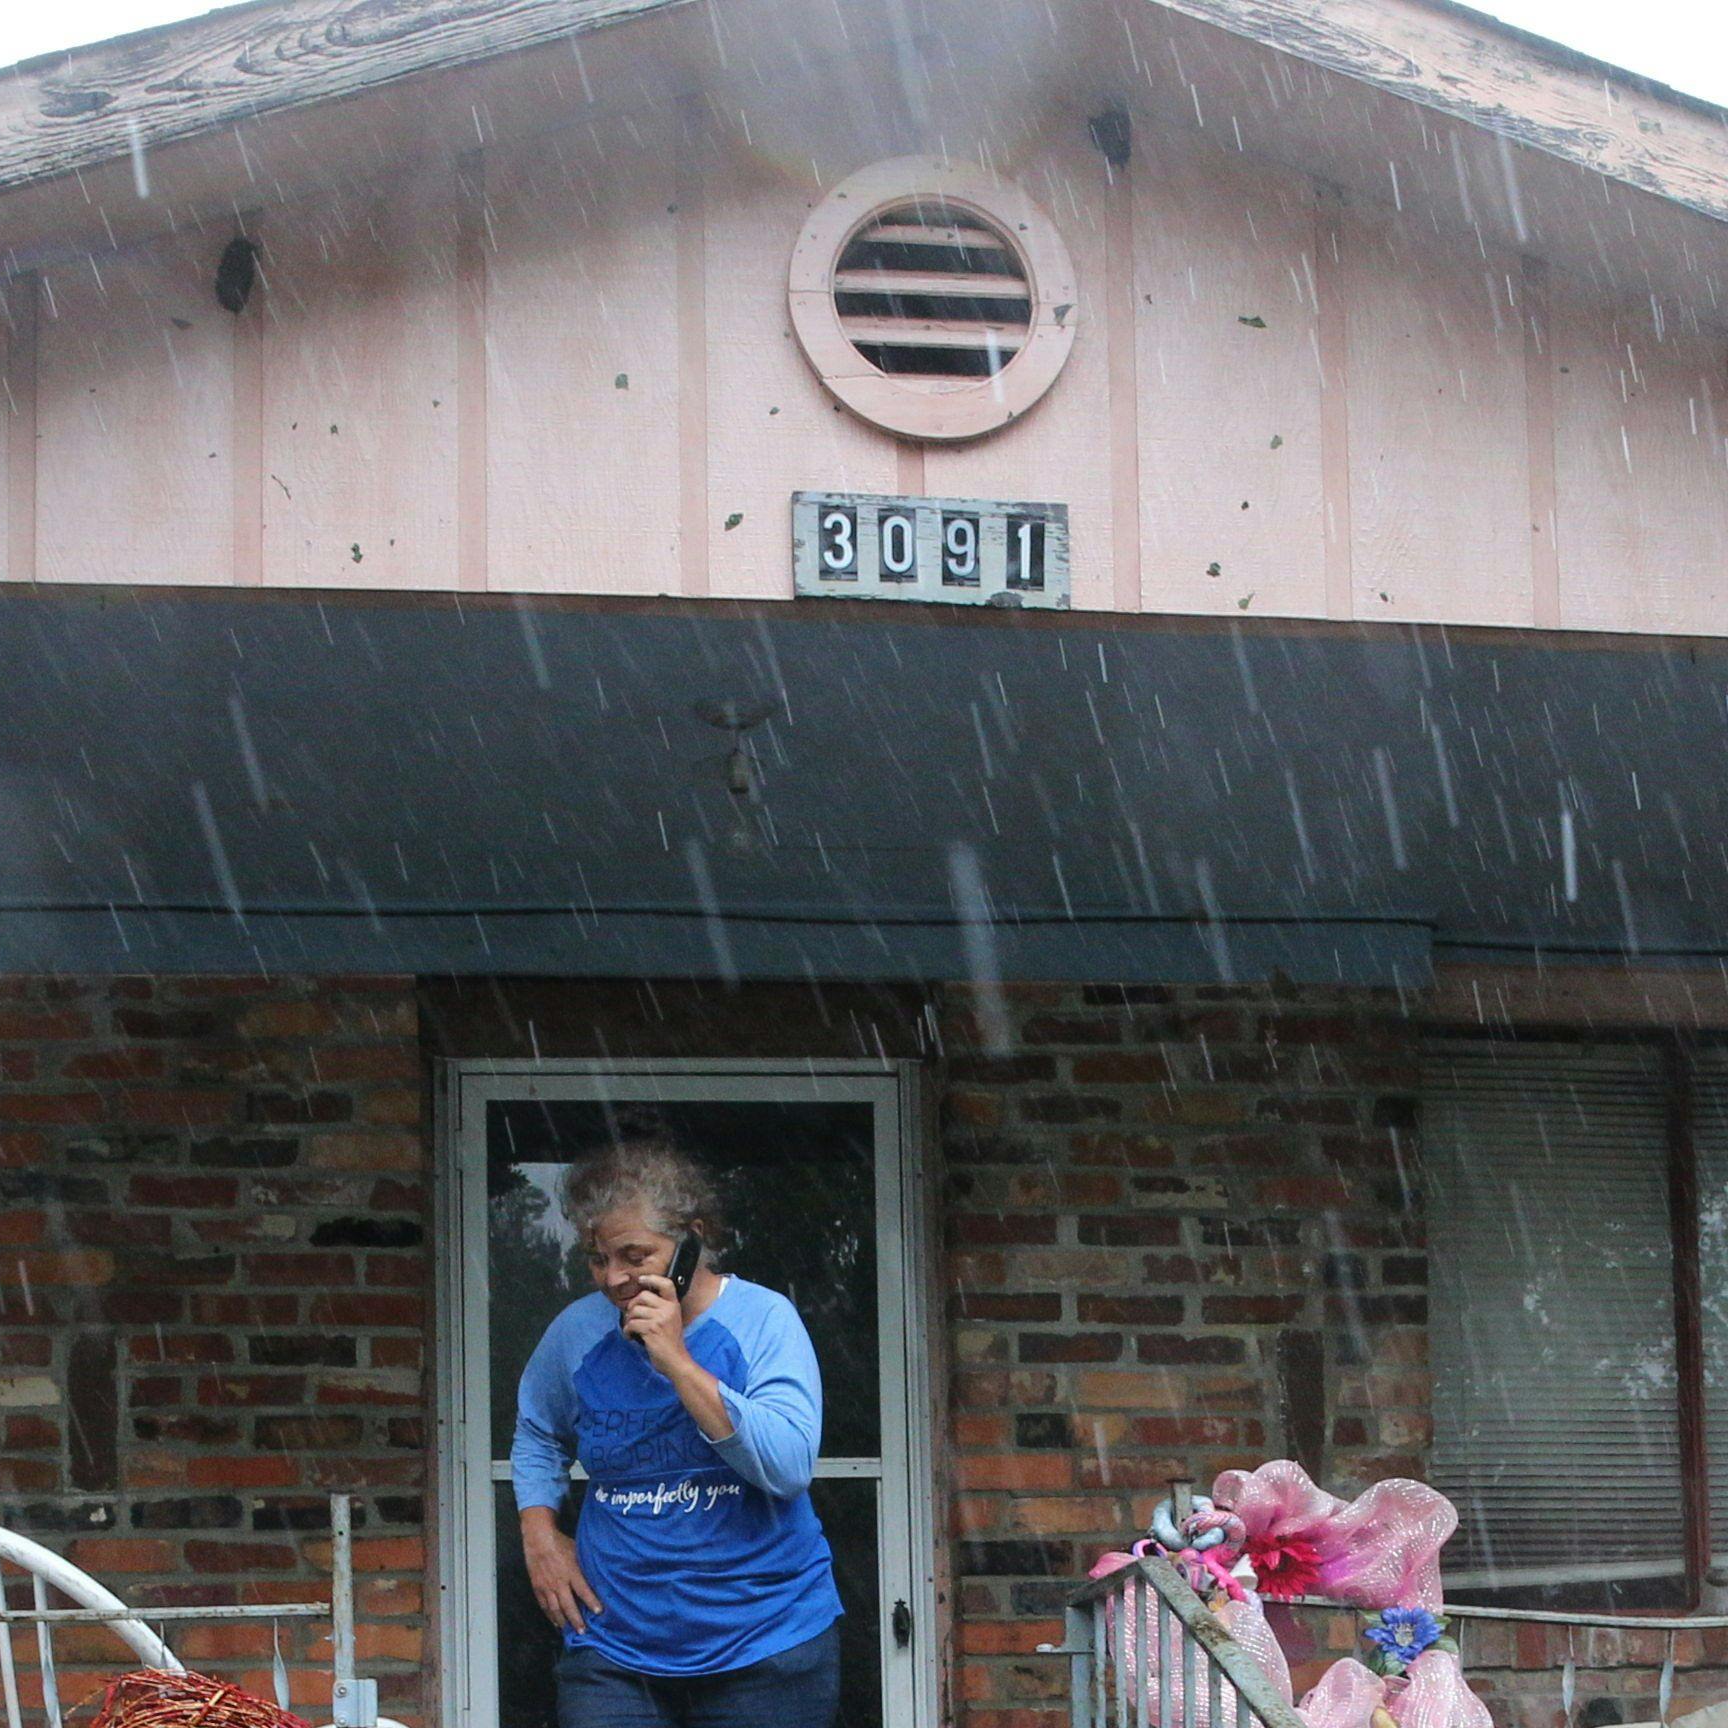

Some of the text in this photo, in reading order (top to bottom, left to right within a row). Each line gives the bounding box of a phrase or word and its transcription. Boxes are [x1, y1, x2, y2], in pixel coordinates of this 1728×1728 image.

[822, 511, 1032, 581] 3091
[610, 1479, 701, 1516] imperfectly
[703, 1484, 741, 1511] you
